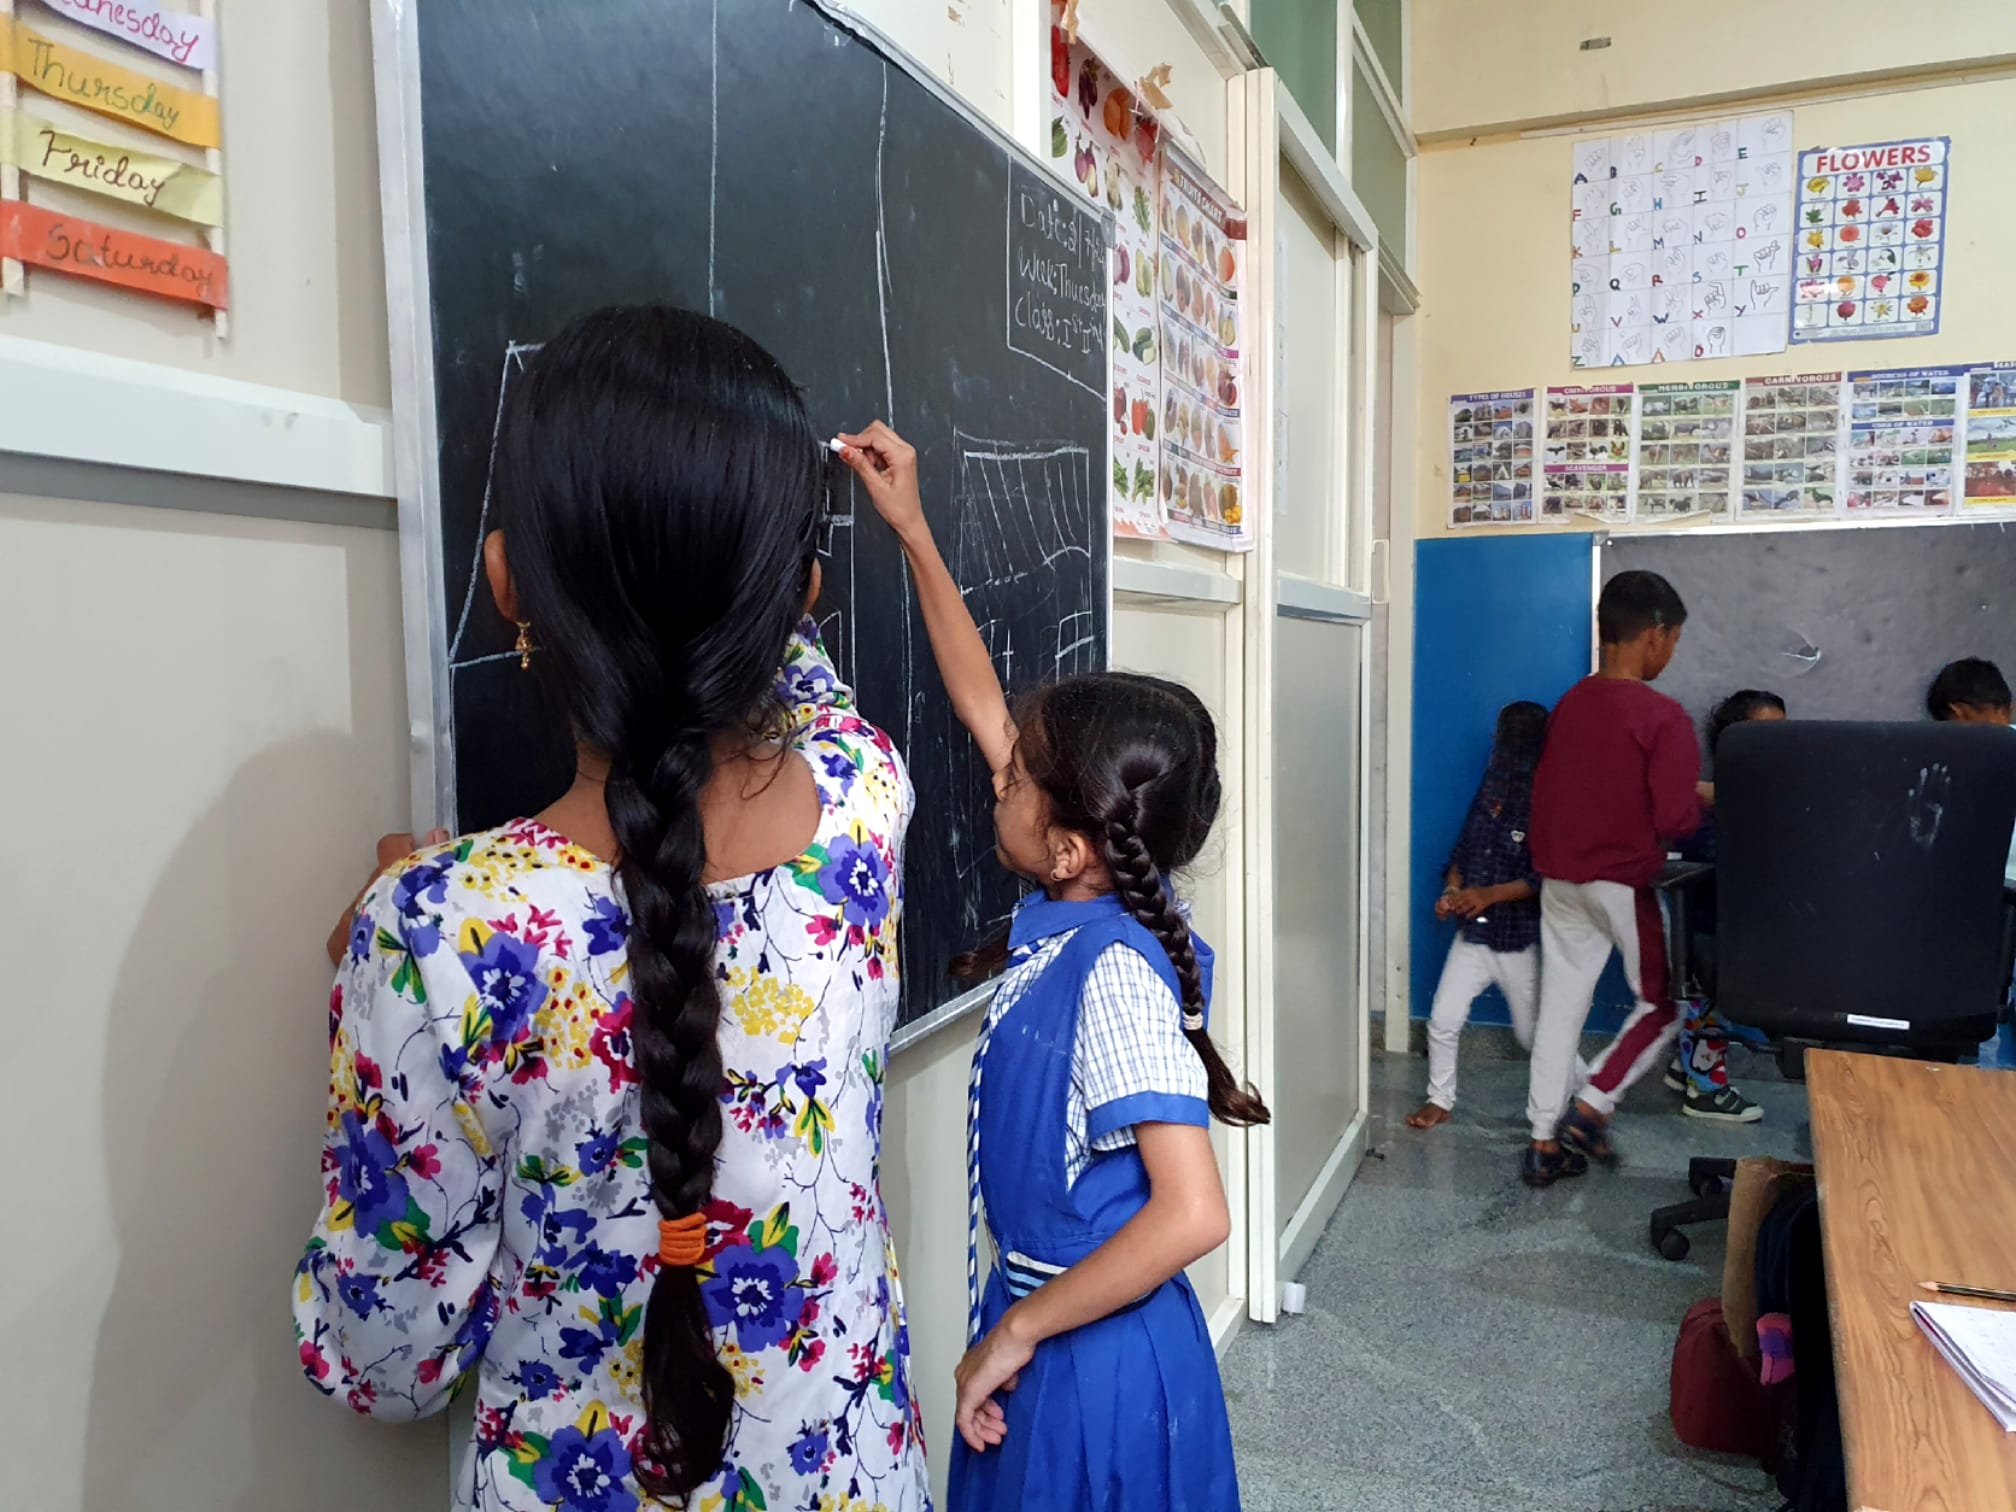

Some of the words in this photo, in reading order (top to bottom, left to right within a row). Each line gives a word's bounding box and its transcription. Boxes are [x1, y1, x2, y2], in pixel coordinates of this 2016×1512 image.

[27, 37, 180, 131] Thursday
[40, 130, 166, 208] Friday
[1574, 172, 1588, 185] A
[1609, 166, 1617, 179] B
[1654, 162, 1663, 172] C
[1694, 156, 1703, 167] D
[1737, 147, 1748, 160] E
[1816, 144, 1931, 174] FLOWERS
[1572, 209, 1582, 222] F
[1609, 202, 1622, 216] G
[1653, 197, 1662, 210] H
[1693, 190, 1707, 204] I
[1735, 183, 1749, 197] J
[1571, 245, 1583, 260] K
[1608, 240, 1622, 255] L
[1653, 237, 1664, 250] M
[1693, 231, 1703, 244] N
[1736, 226, 1747, 239] O
[46, 223, 214, 296] Saturday
[1609, 278, 1621, 291] Q
[1652, 274, 1664, 287] R
[1692, 271, 1702, 284] S
[1733, 264, 1749, 276] T
[1571, 323, 1581, 333] U
[1610, 316, 1622, 327] V
[1653, 313, 1669, 324] W
[1692, 310, 1703, 320] X
[1734, 305, 1746, 317] Y
[1572, 356, 1585, 367] Z
[1659, 383, 1729, 392] HERBIVOROUS
[1765, 374, 1836, 385] CARNIVOROUS
[1564, 464, 1607, 472] SCAVENGER
